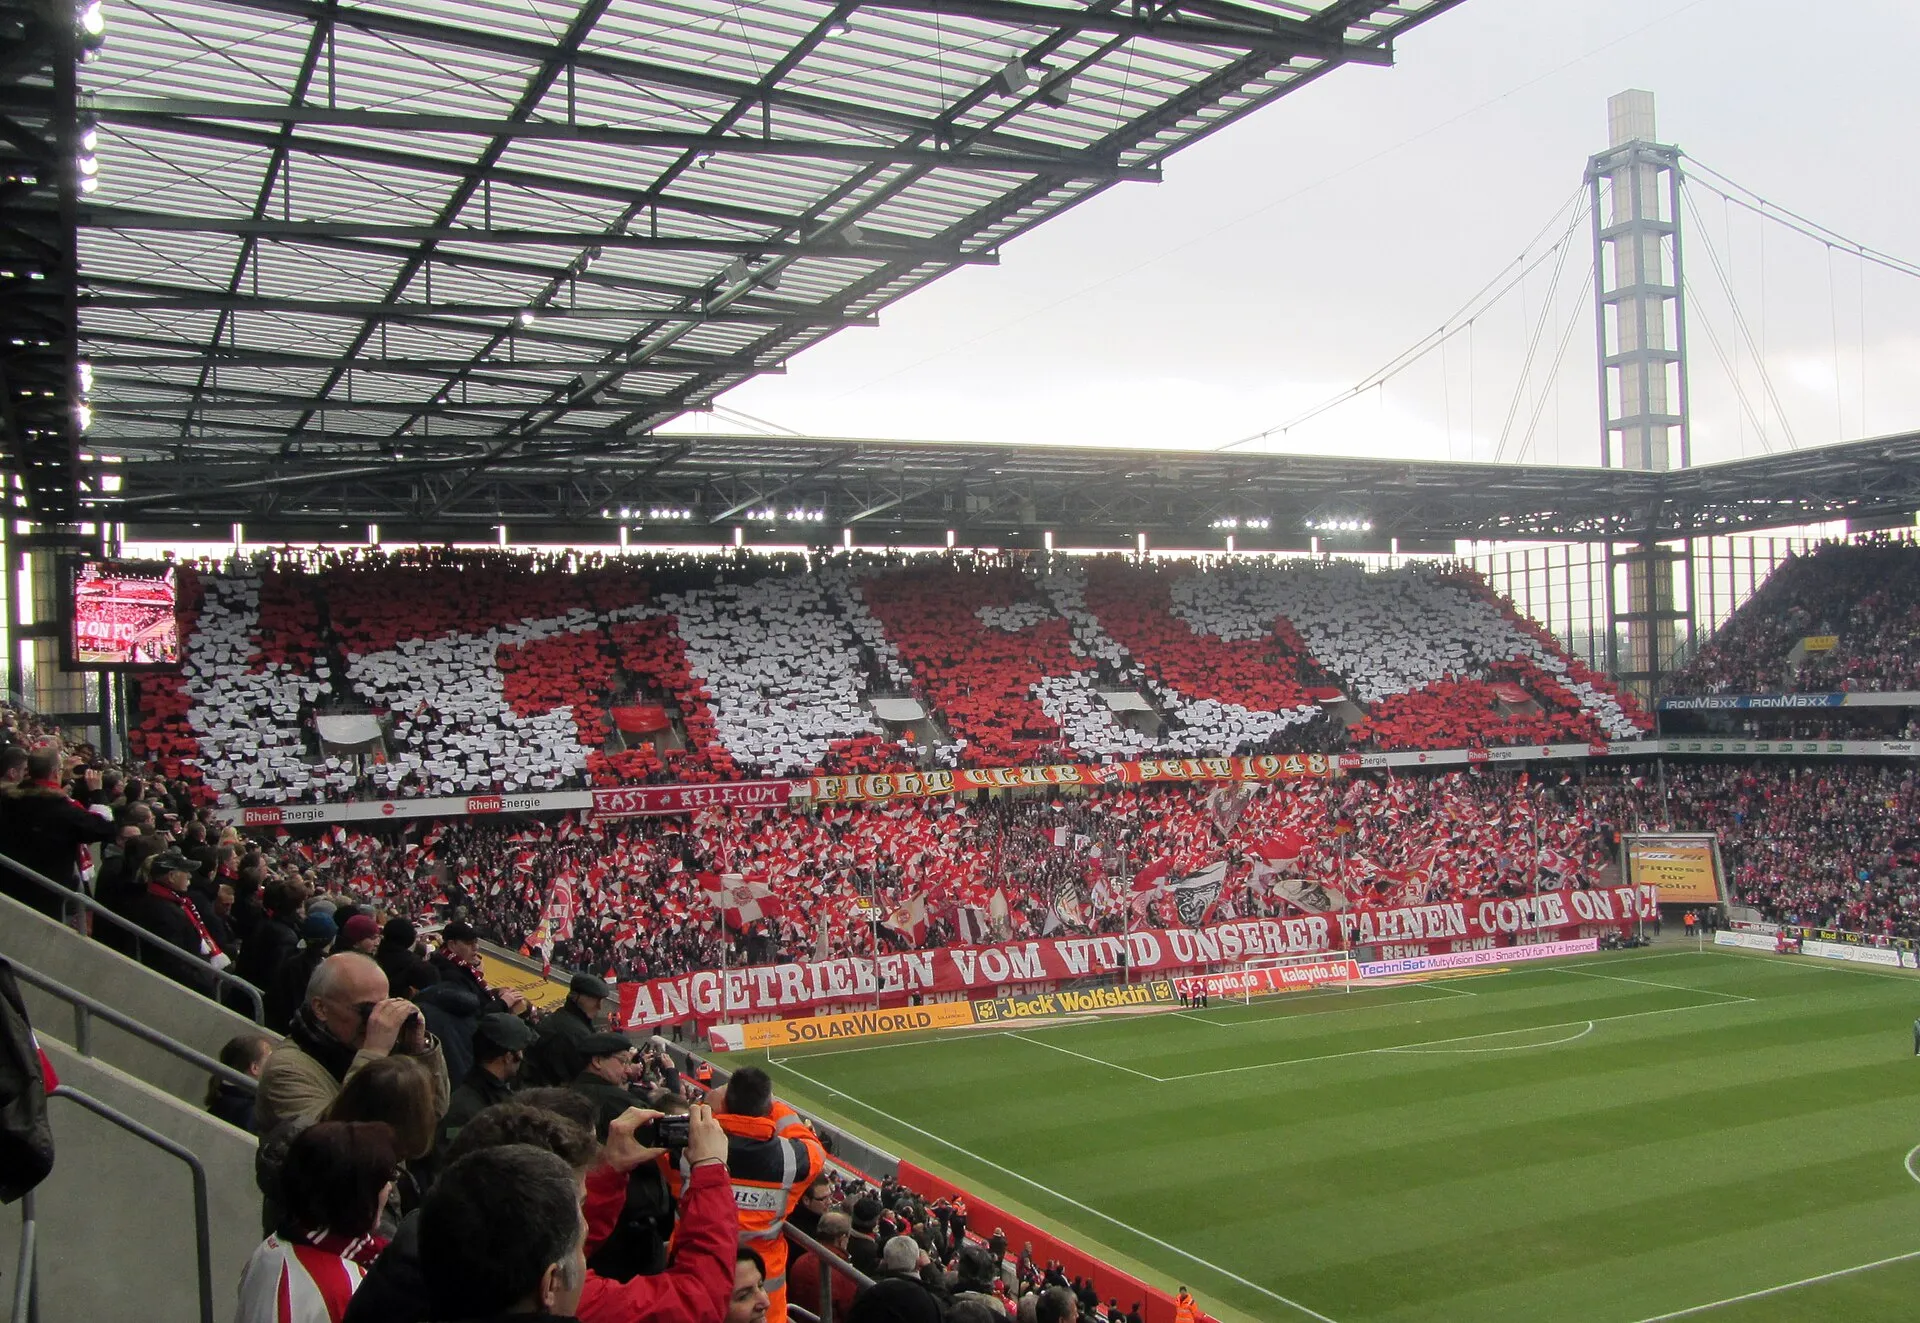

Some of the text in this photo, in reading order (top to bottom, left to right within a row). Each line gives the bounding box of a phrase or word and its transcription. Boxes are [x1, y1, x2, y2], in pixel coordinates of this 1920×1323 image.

[1139, 758, 1233, 780] SEIT
[1241, 754, 1329, 778] 1948
[1339, 756, 1387, 766] RheinEnergie
[469, 798, 541, 811] RheinEnergie
[595, 786, 778, 811] EAST BELGIUM
[245, 809, 325, 823] RheinEnergie
[1640, 864, 1705, 873] Fitness
[1451, 936, 1497, 953] REWE
[1516, 929, 1561, 946] REWE
[627, 951, 935, 1027] ANGETRIEBEN
[950, 942, 1047, 985] VOM
[1055, 931, 1161, 975] WIND
[1164, 916, 1330, 963] UNSERER
[1571, 889, 1615, 920] ON
[1618, 884, 1658, 919] FC!
[1360, 960, 1426, 975] TechniSat
[1545, 944, 1556, 954] TV
[1565, 941, 1595, 953] Internet
[1382, 944, 1430, 960] REWE
[1280, 964, 1348, 983] kalaydo.de
[1001, 984, 1152, 1019] Jack Wolfskin
[785, 1012, 932, 1042] SOLARWORLD
